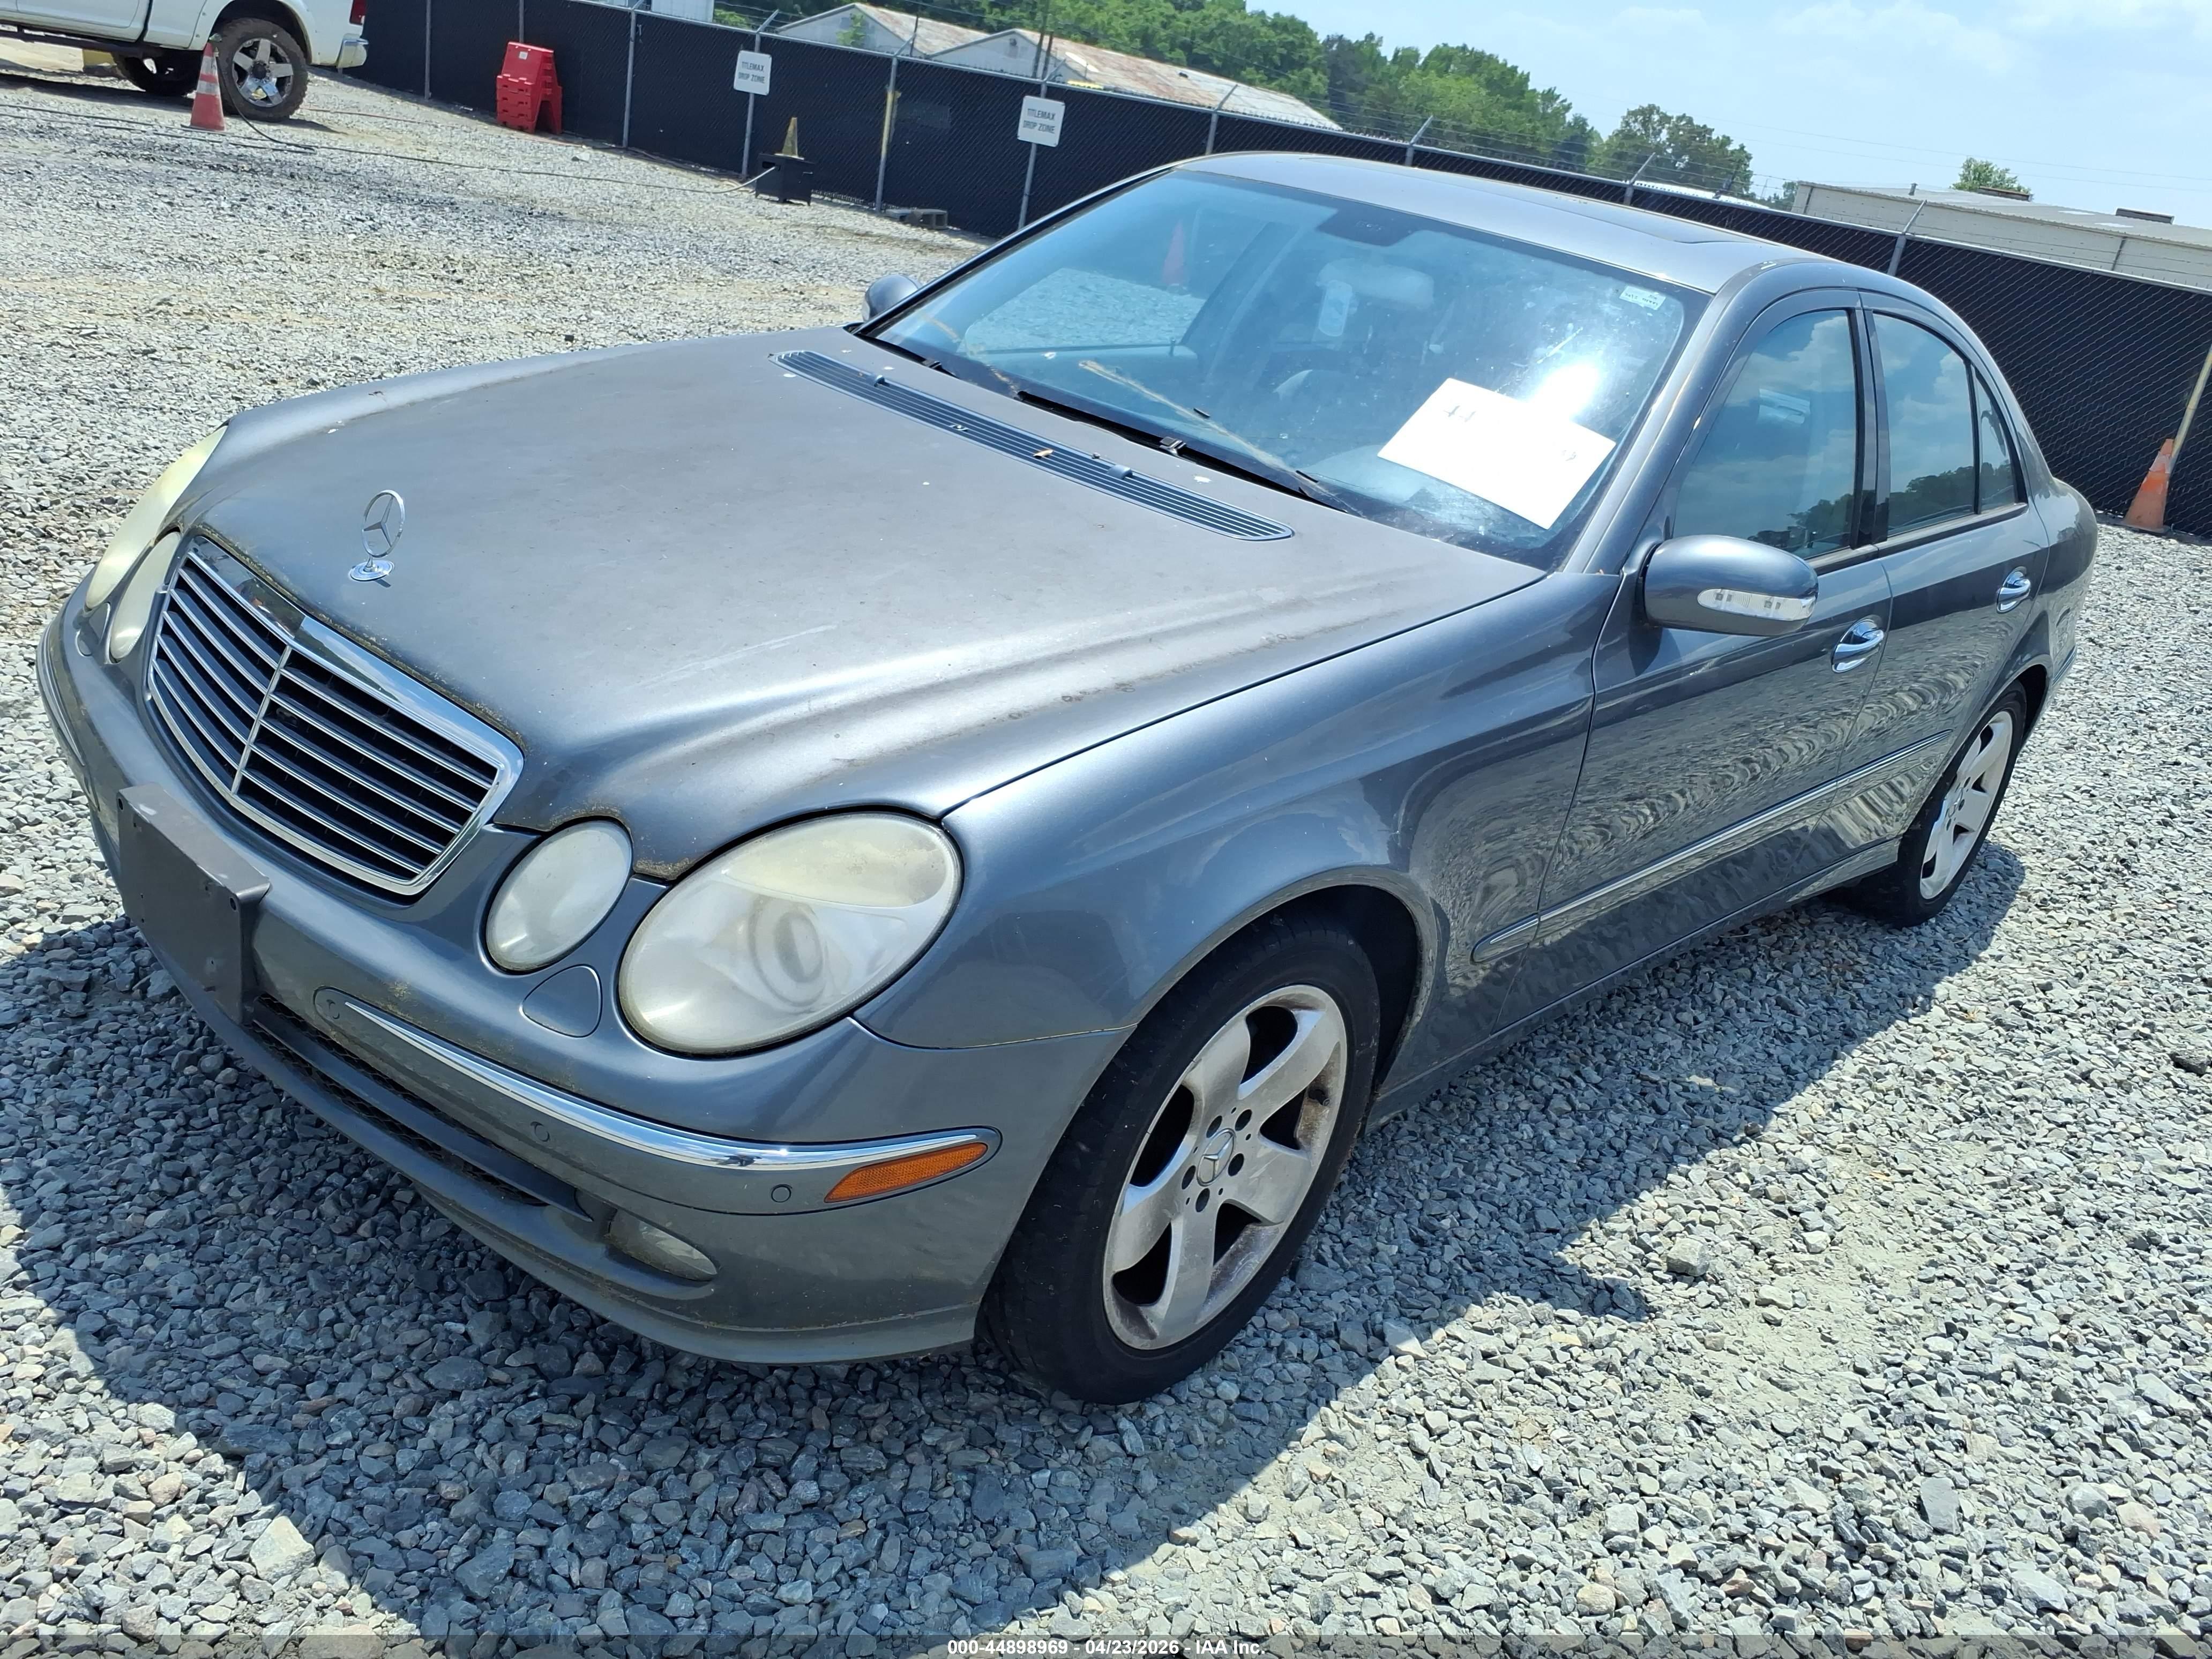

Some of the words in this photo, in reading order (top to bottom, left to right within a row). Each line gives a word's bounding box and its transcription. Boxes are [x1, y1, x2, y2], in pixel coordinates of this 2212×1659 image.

[751, 74, 765, 84] ZONE
[1027, 108, 1056, 121] TITLEMAX
[1037, 123, 1055, 134] ZONE
